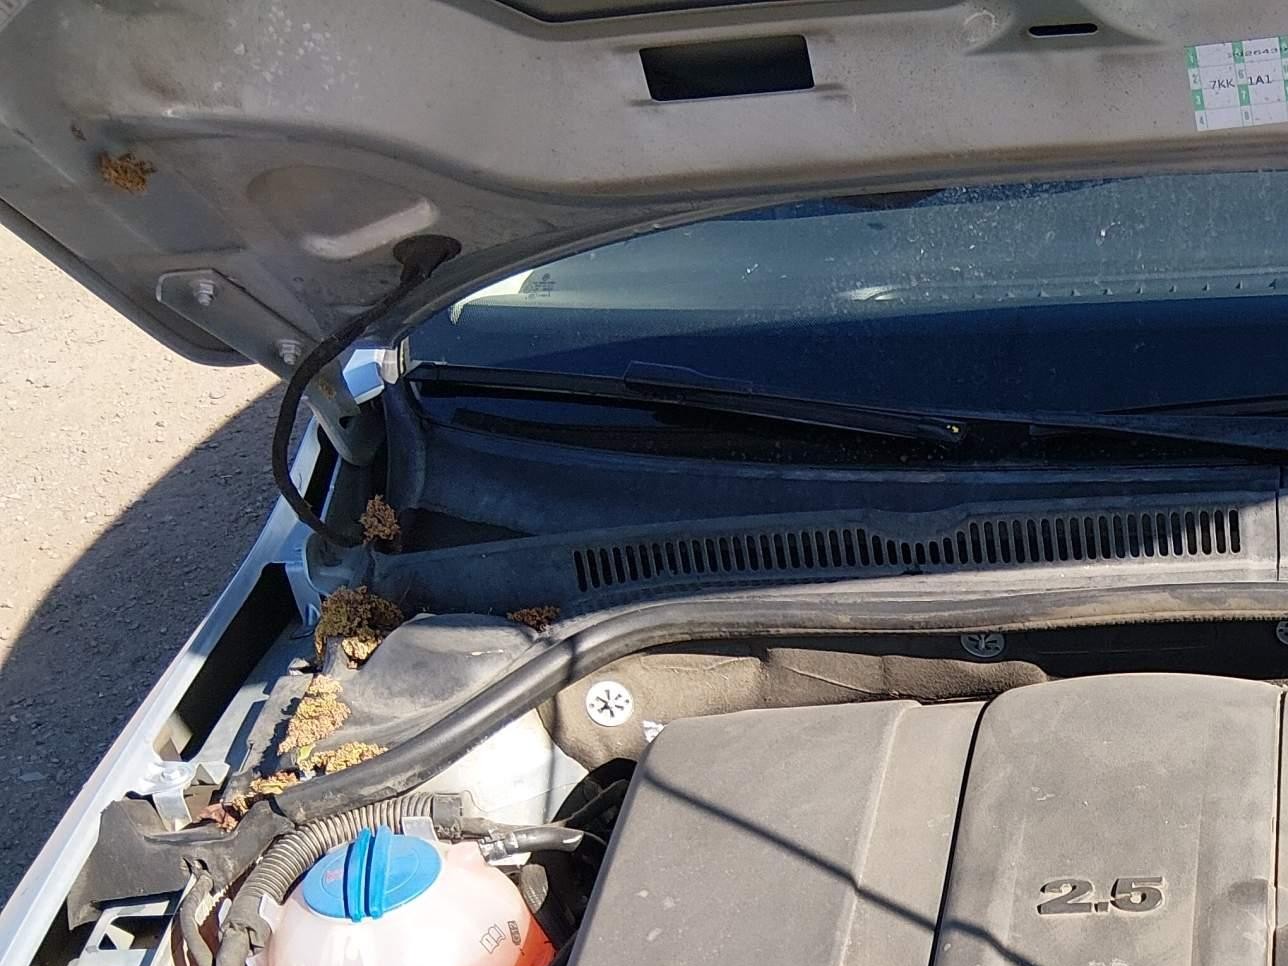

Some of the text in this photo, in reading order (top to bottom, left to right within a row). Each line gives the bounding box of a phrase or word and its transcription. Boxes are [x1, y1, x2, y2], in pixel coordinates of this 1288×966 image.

[1210, 79, 1236, 90] 7KK
[1248, 75, 1273, 86] 1A1
[1037, 876, 1167, 914] 2.5
